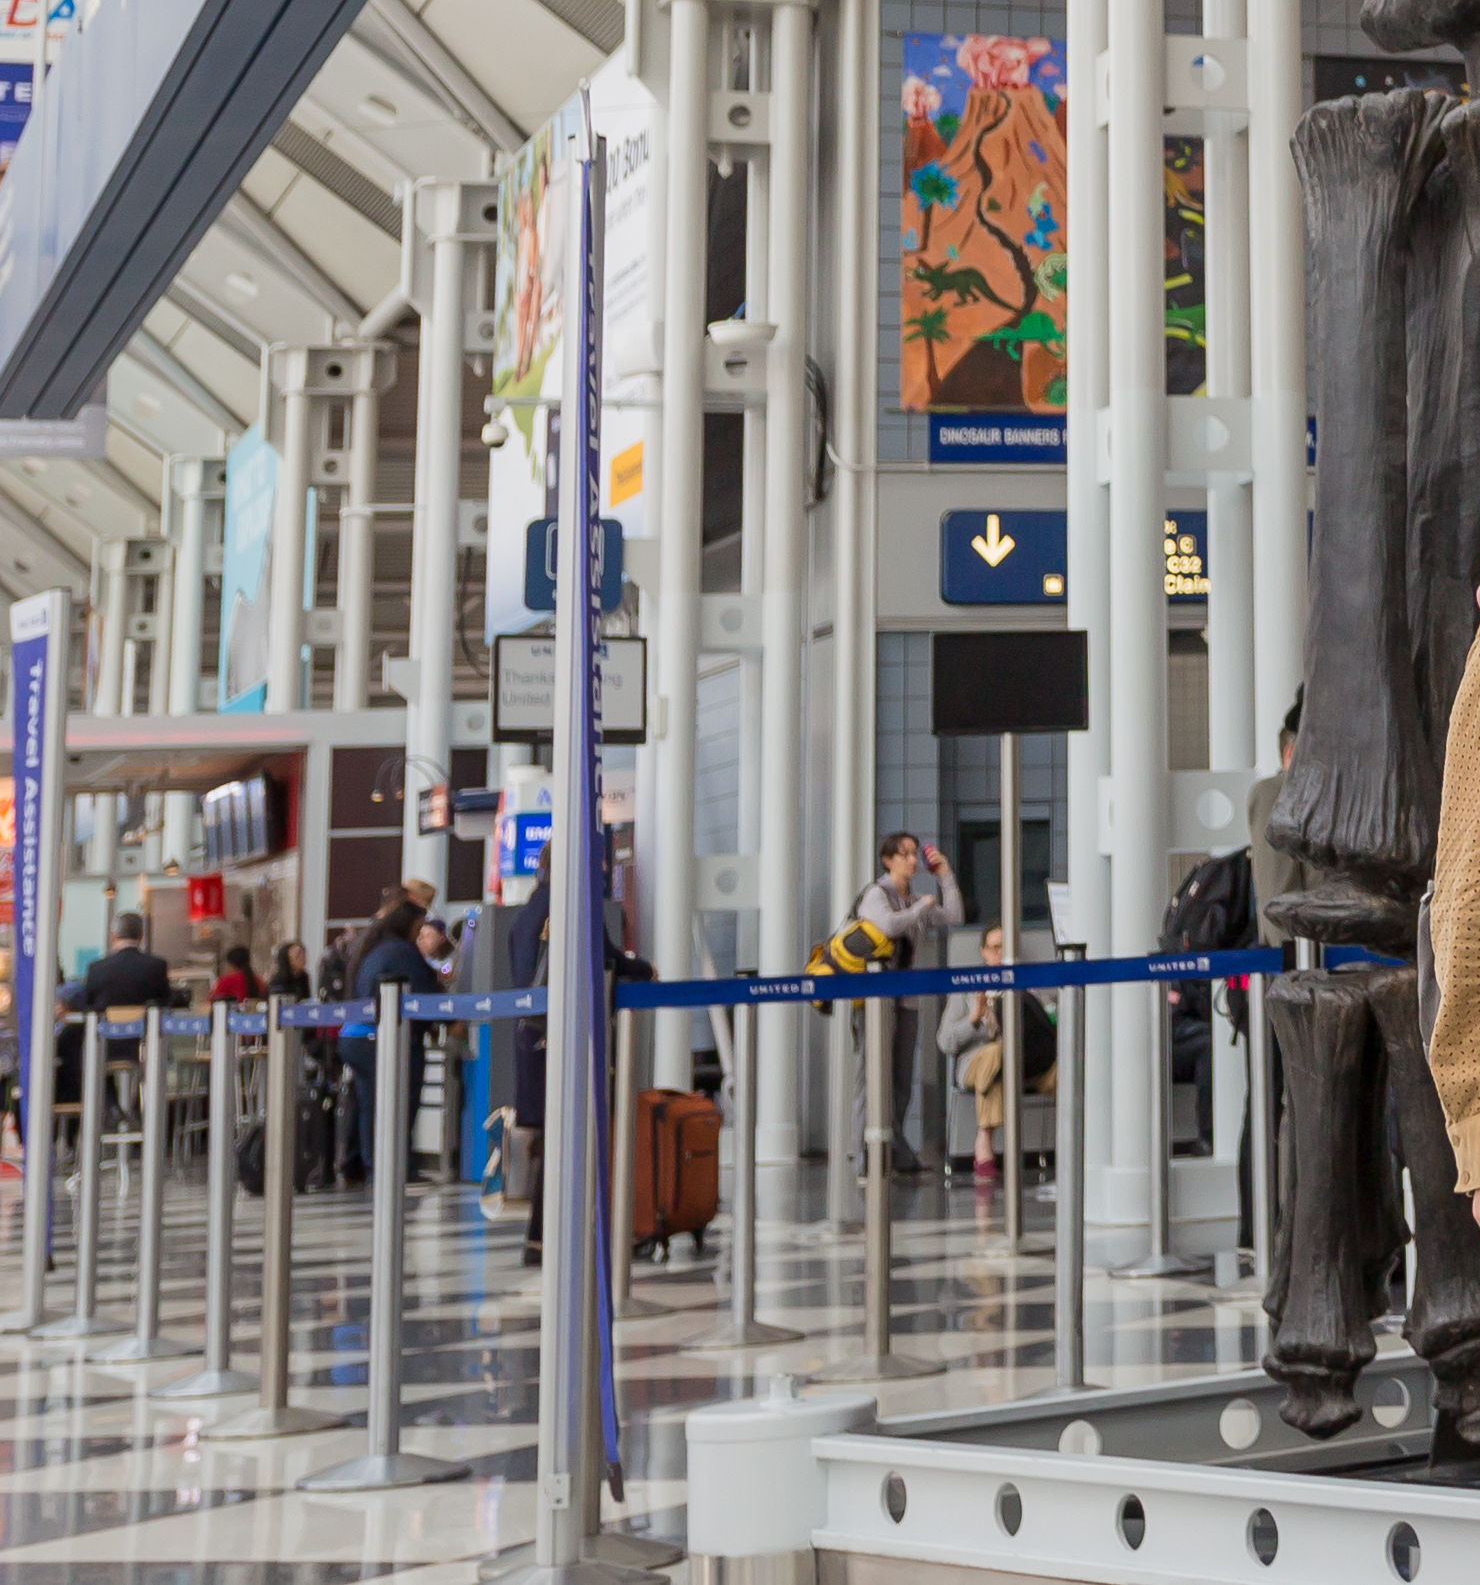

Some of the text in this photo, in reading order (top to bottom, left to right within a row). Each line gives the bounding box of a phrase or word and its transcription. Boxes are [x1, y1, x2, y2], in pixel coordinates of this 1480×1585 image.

[940, 427, 1002, 445] DINOSAUR
[1004, 428, 1060, 446] BANNERS
[22, 657, 43, 958] Travel Assistance
[951, 972, 1001, 985] UNITED
[749, 982, 800, 996] UNITED
